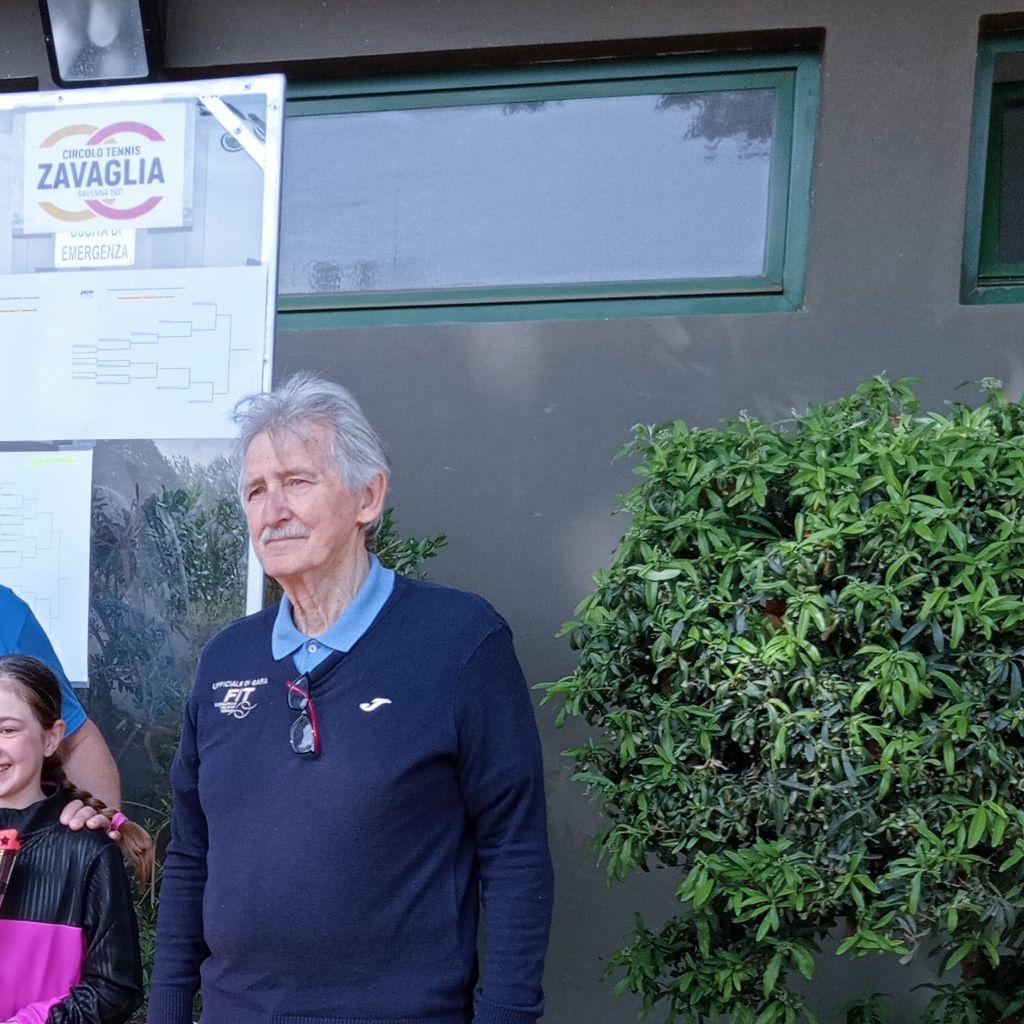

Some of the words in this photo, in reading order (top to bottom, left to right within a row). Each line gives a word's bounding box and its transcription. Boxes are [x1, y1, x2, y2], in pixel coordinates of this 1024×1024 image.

[62, 148, 103, 160] CIRCOLO
[106, 145, 141, 157] TENNIS
[37, 157, 165, 190] ZAVAGLIA
[61, 244, 129, 261] EMERGENZA
[223, 687, 256, 703] FIT
